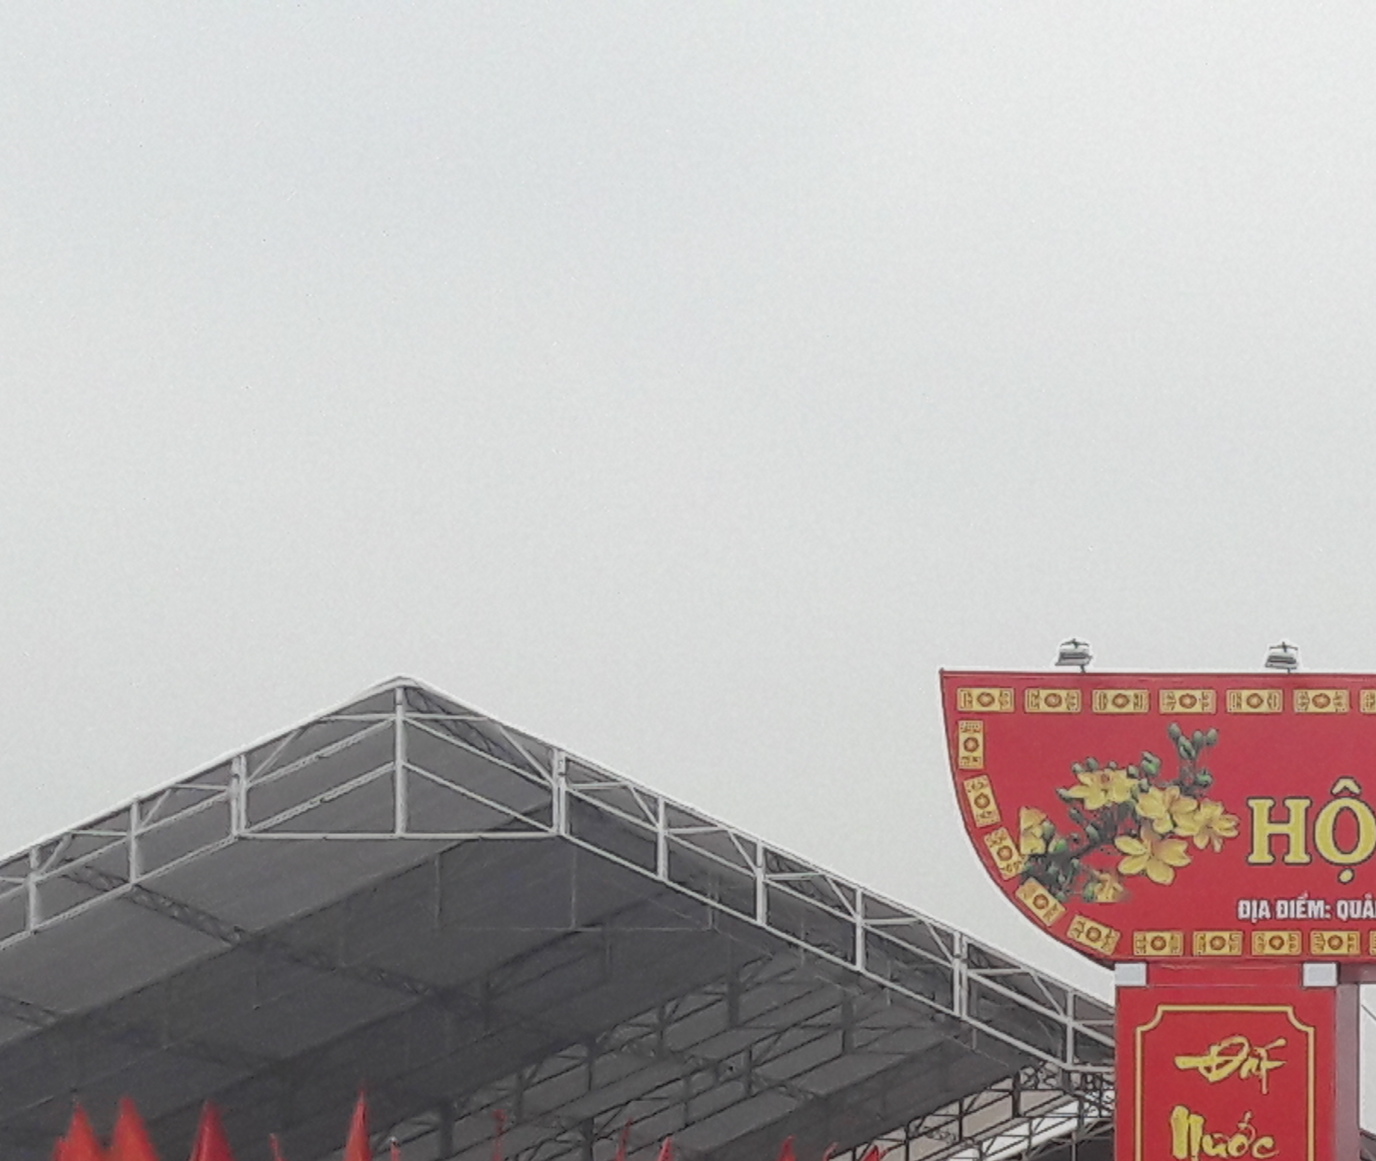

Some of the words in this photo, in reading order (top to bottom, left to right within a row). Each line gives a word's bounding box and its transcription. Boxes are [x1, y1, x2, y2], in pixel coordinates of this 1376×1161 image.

[1237, 898, 1271, 923] ĐỊA
[1275, 891, 1331, 920] ĐIỂM:
[1174, 1035, 1286, 1095] Đất
